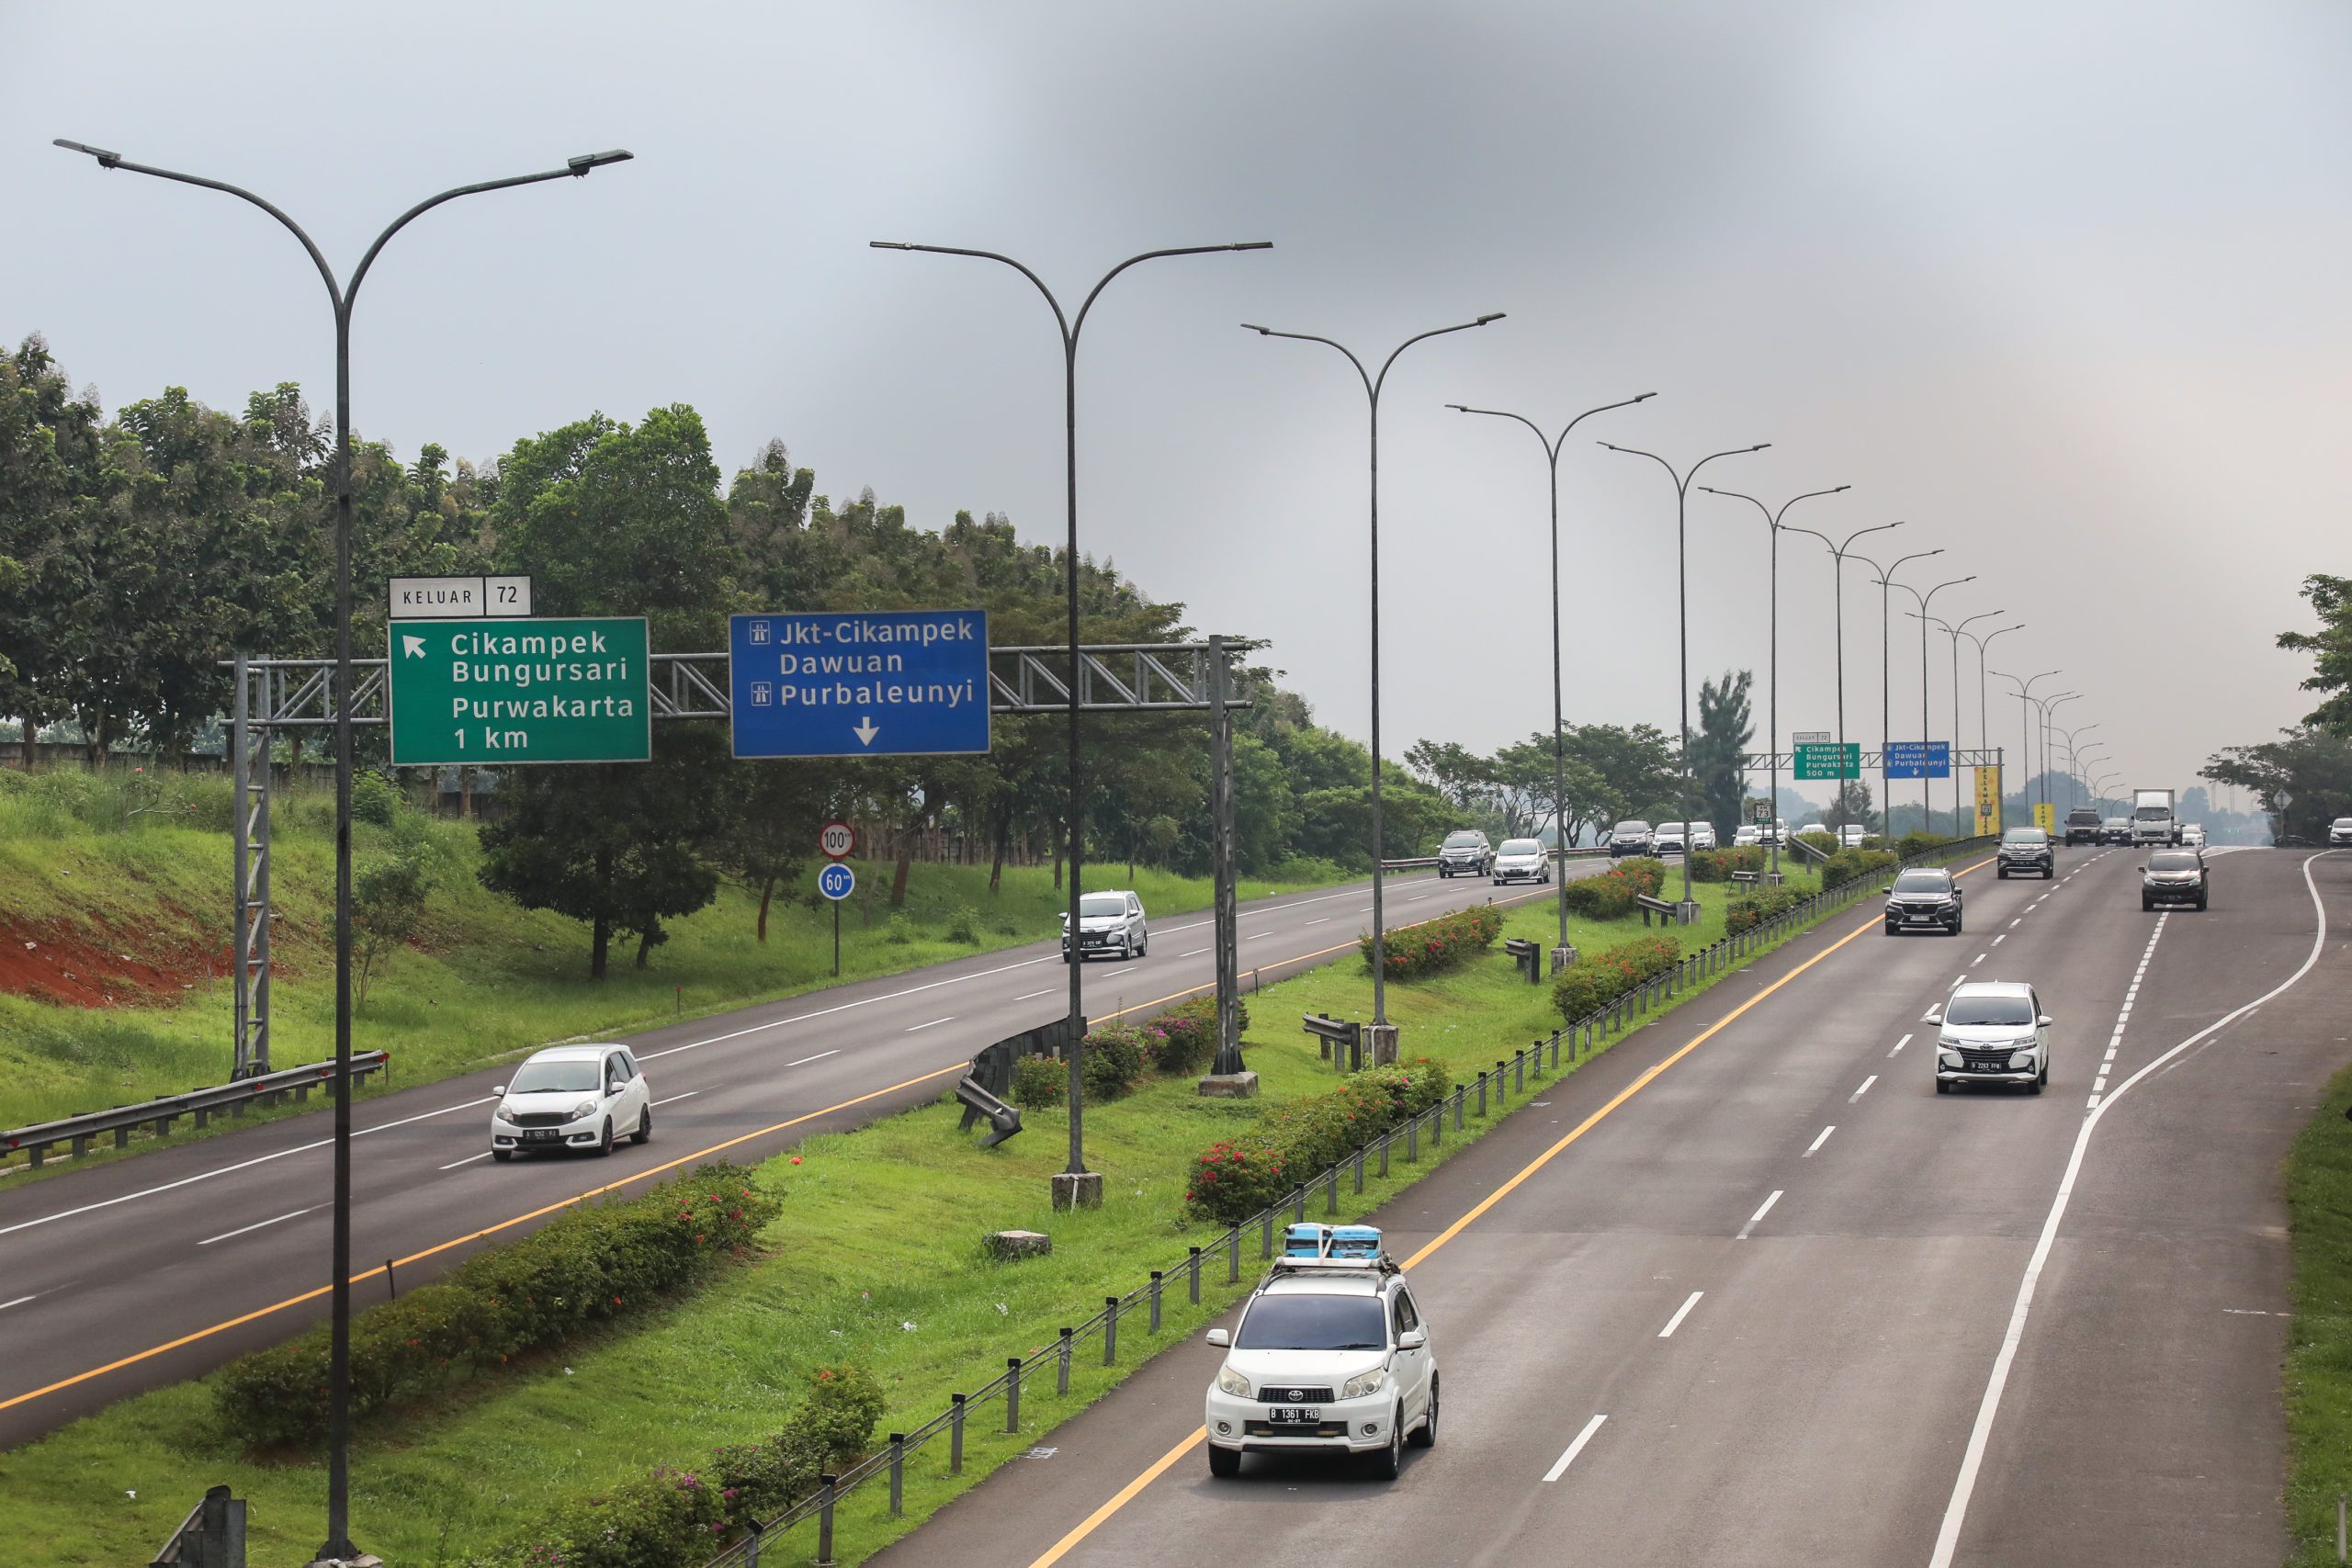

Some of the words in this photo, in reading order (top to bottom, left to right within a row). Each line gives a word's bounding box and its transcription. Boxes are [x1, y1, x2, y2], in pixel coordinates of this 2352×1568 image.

[402, 590, 472, 604] KELUAR
[496, 586, 517, 604] 72
[780, 617, 974, 647] Jkt-Cikampek
[451, 630, 607, 660] Cikampek
[452, 657, 627, 688] Bungursari
[780, 653, 903, 675] Dawuan
[781, 679, 973, 708] Purbaleunyi
[453, 694, 634, 718] Purwakarta
[454, 728, 465, 750] 1
[485, 727, 528, 749] km
[824, 831, 844, 848] 100
[826, 874, 842, 891] 60
[1271, 1409, 1276, 1418] B
[1282, 1409, 1299, 1418] 1361
[1305, 1409, 1319, 1419] FKB
